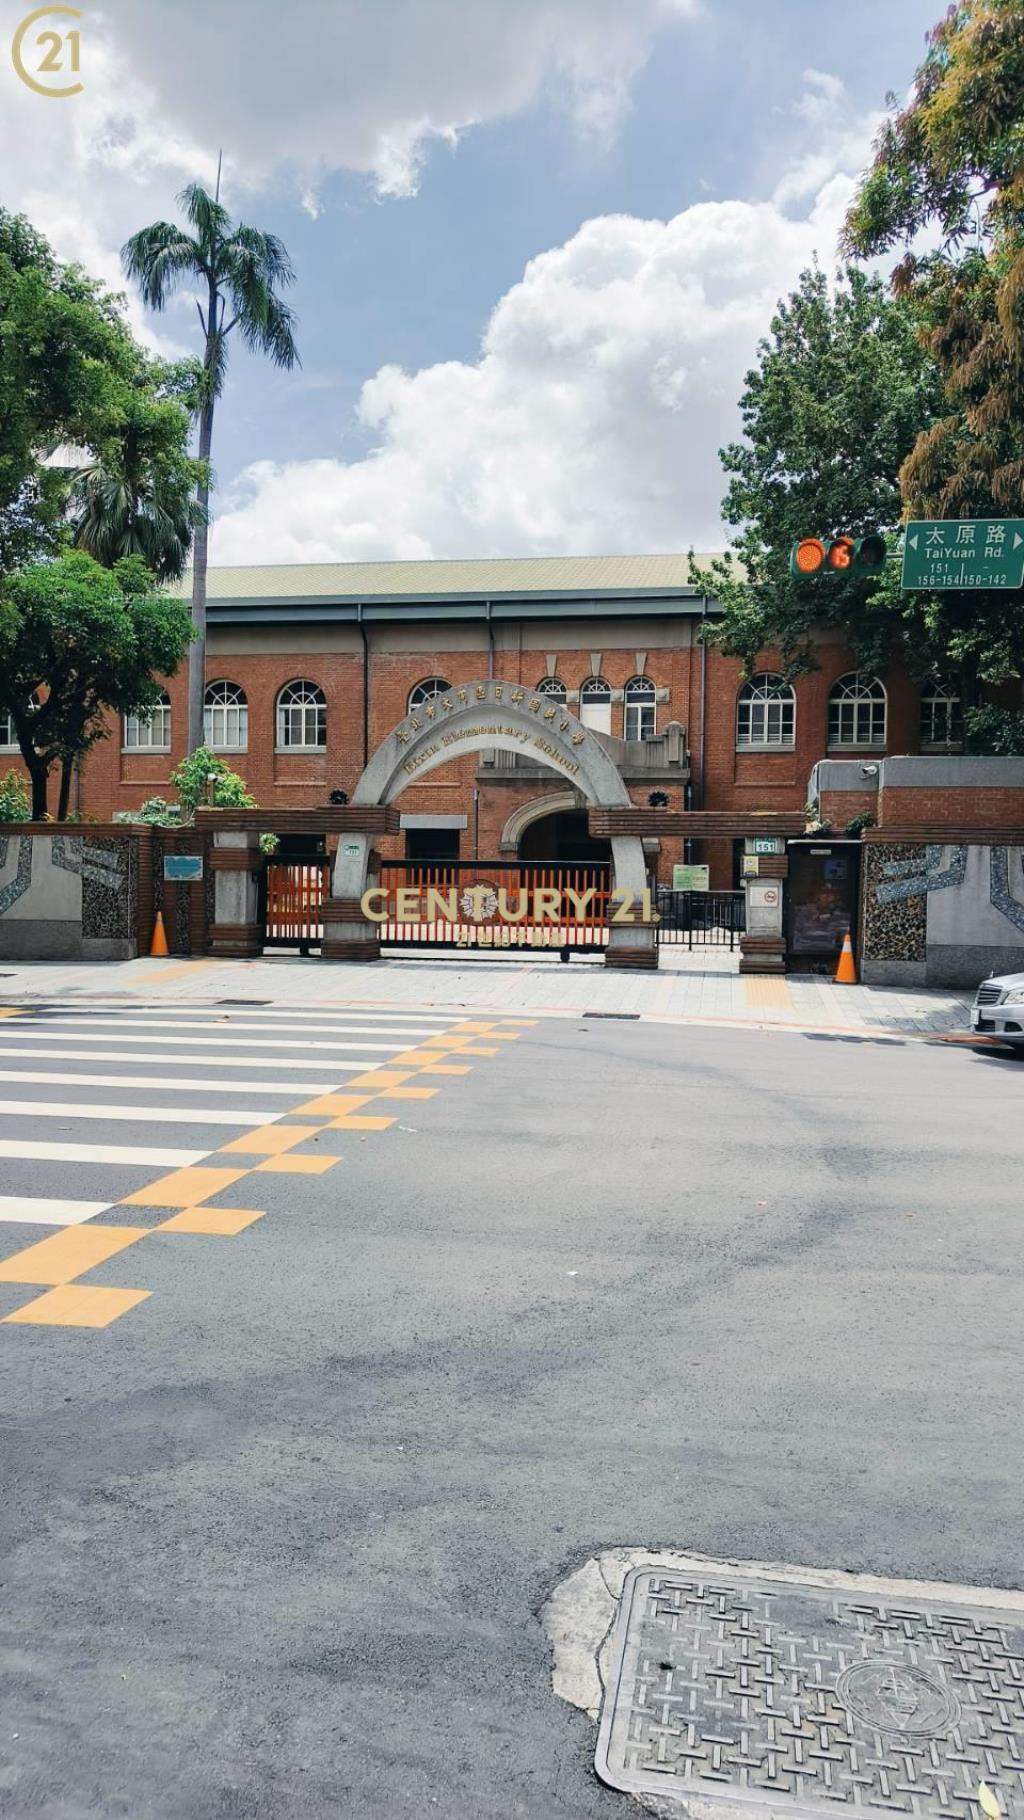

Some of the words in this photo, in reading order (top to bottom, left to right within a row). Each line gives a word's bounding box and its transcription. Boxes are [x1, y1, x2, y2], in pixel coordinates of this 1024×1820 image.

[925, 525, 1006, 544] 太原路
[924, 548, 976, 559] TaiYuan
[984, 547, 1005, 558] Rd.
[931, 563, 949, 573] 151
[918, 575, 960, 585] 156-154
[964, 574, 1007, 585] 150-142
[534, 735, 579, 776] School
[758, 843, 774, 851] 151
